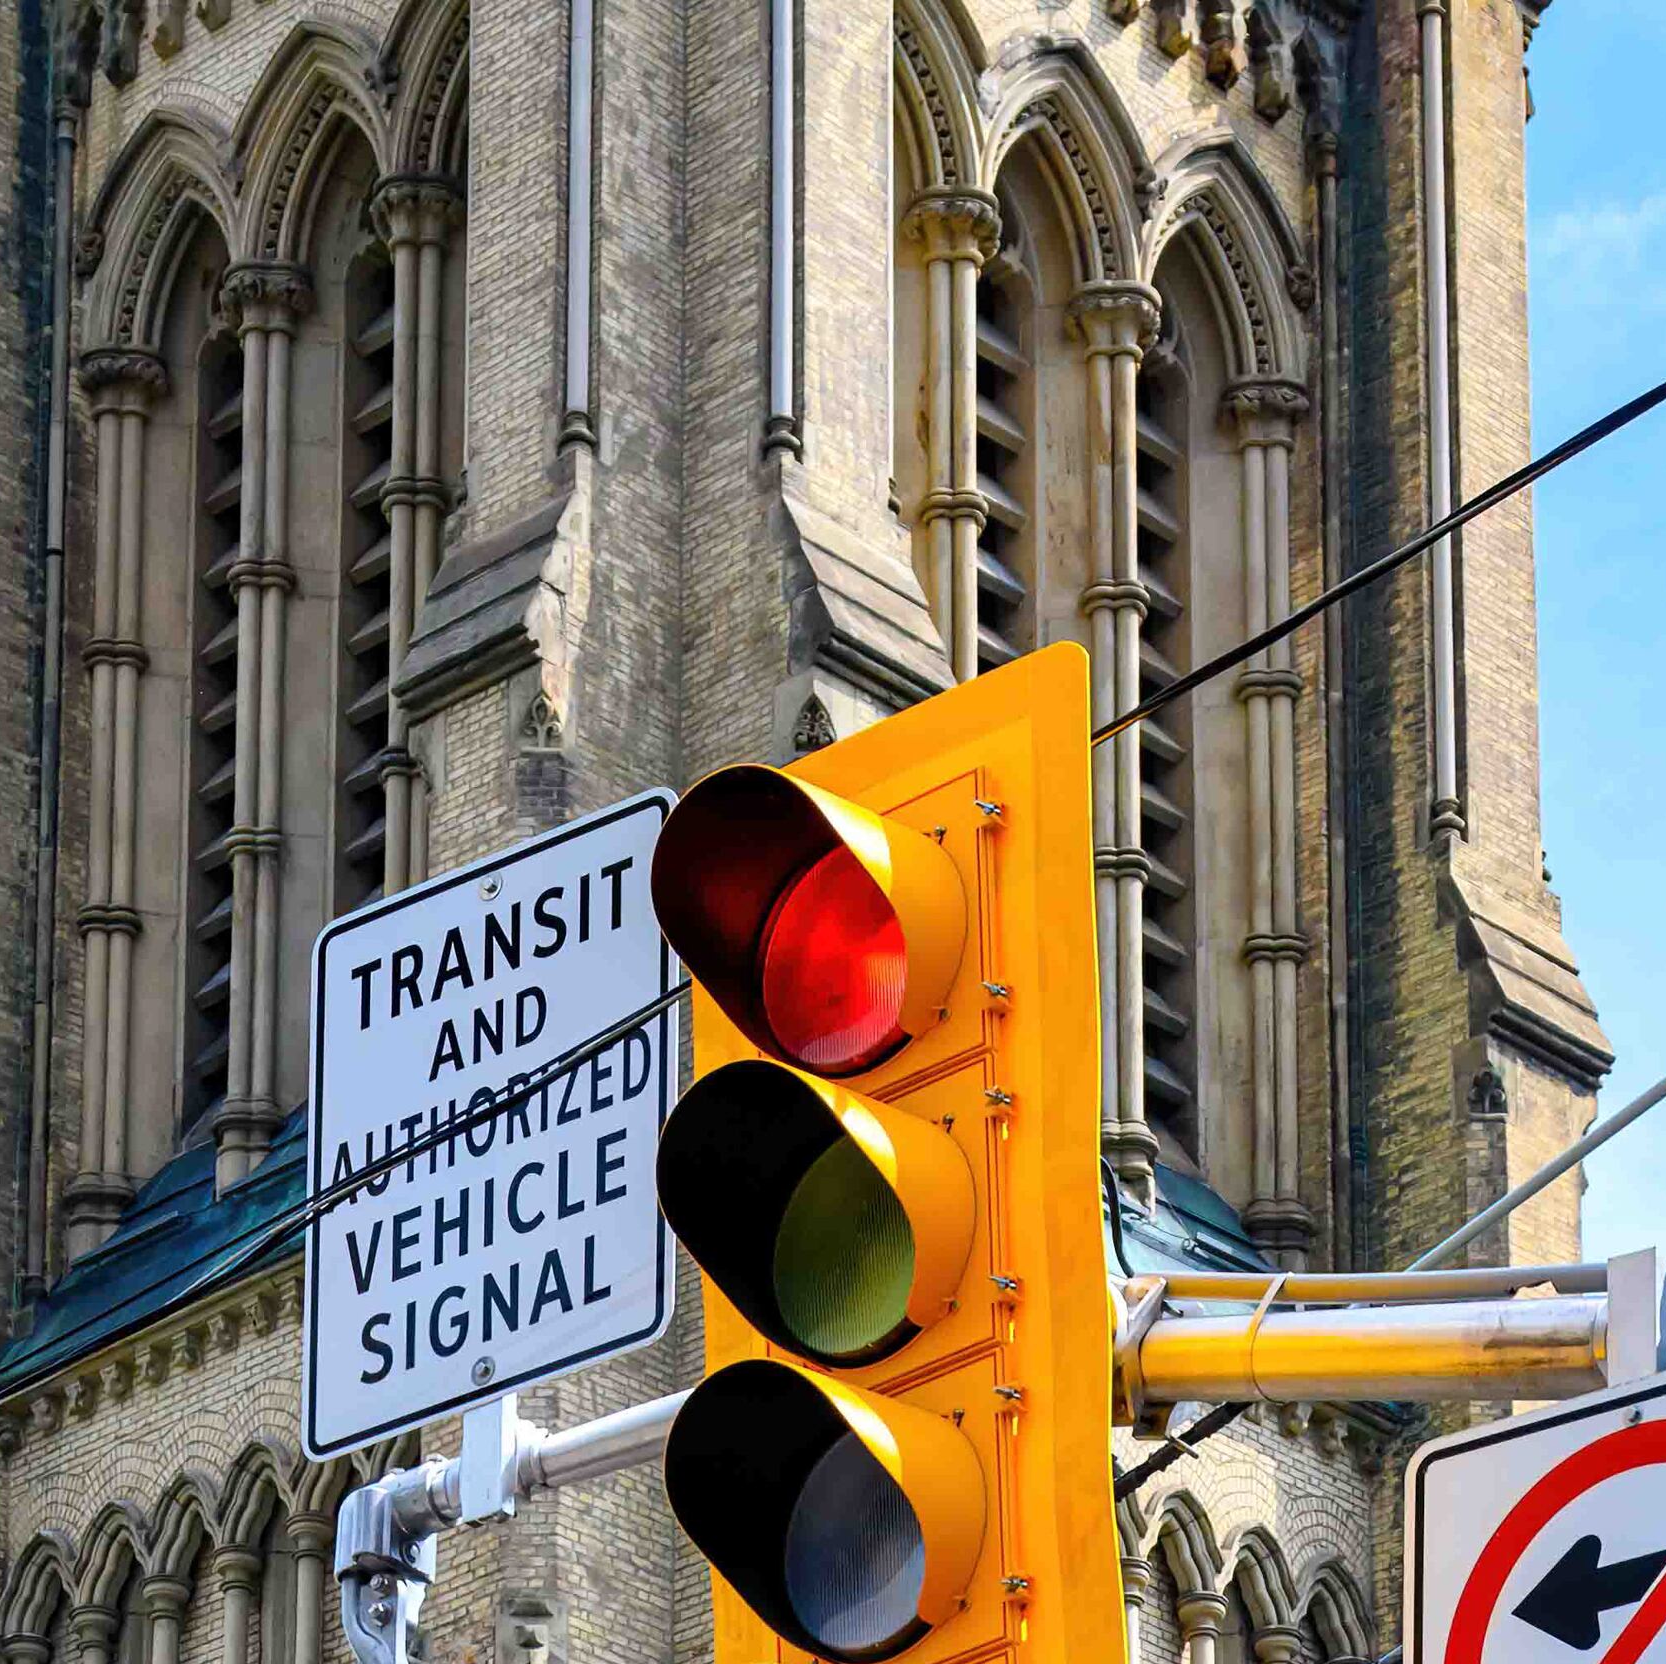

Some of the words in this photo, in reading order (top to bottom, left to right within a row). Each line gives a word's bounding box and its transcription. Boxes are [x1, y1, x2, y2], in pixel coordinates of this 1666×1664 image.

[350, 855, 634, 1031] TRANSIT
[326, 1025, 651, 1211] AUTHORIZED
[428, 986, 547, 1082] AND
[346, 1127, 628, 1295] VEHICLE
[360, 1234, 612, 1385] SIGNAL
